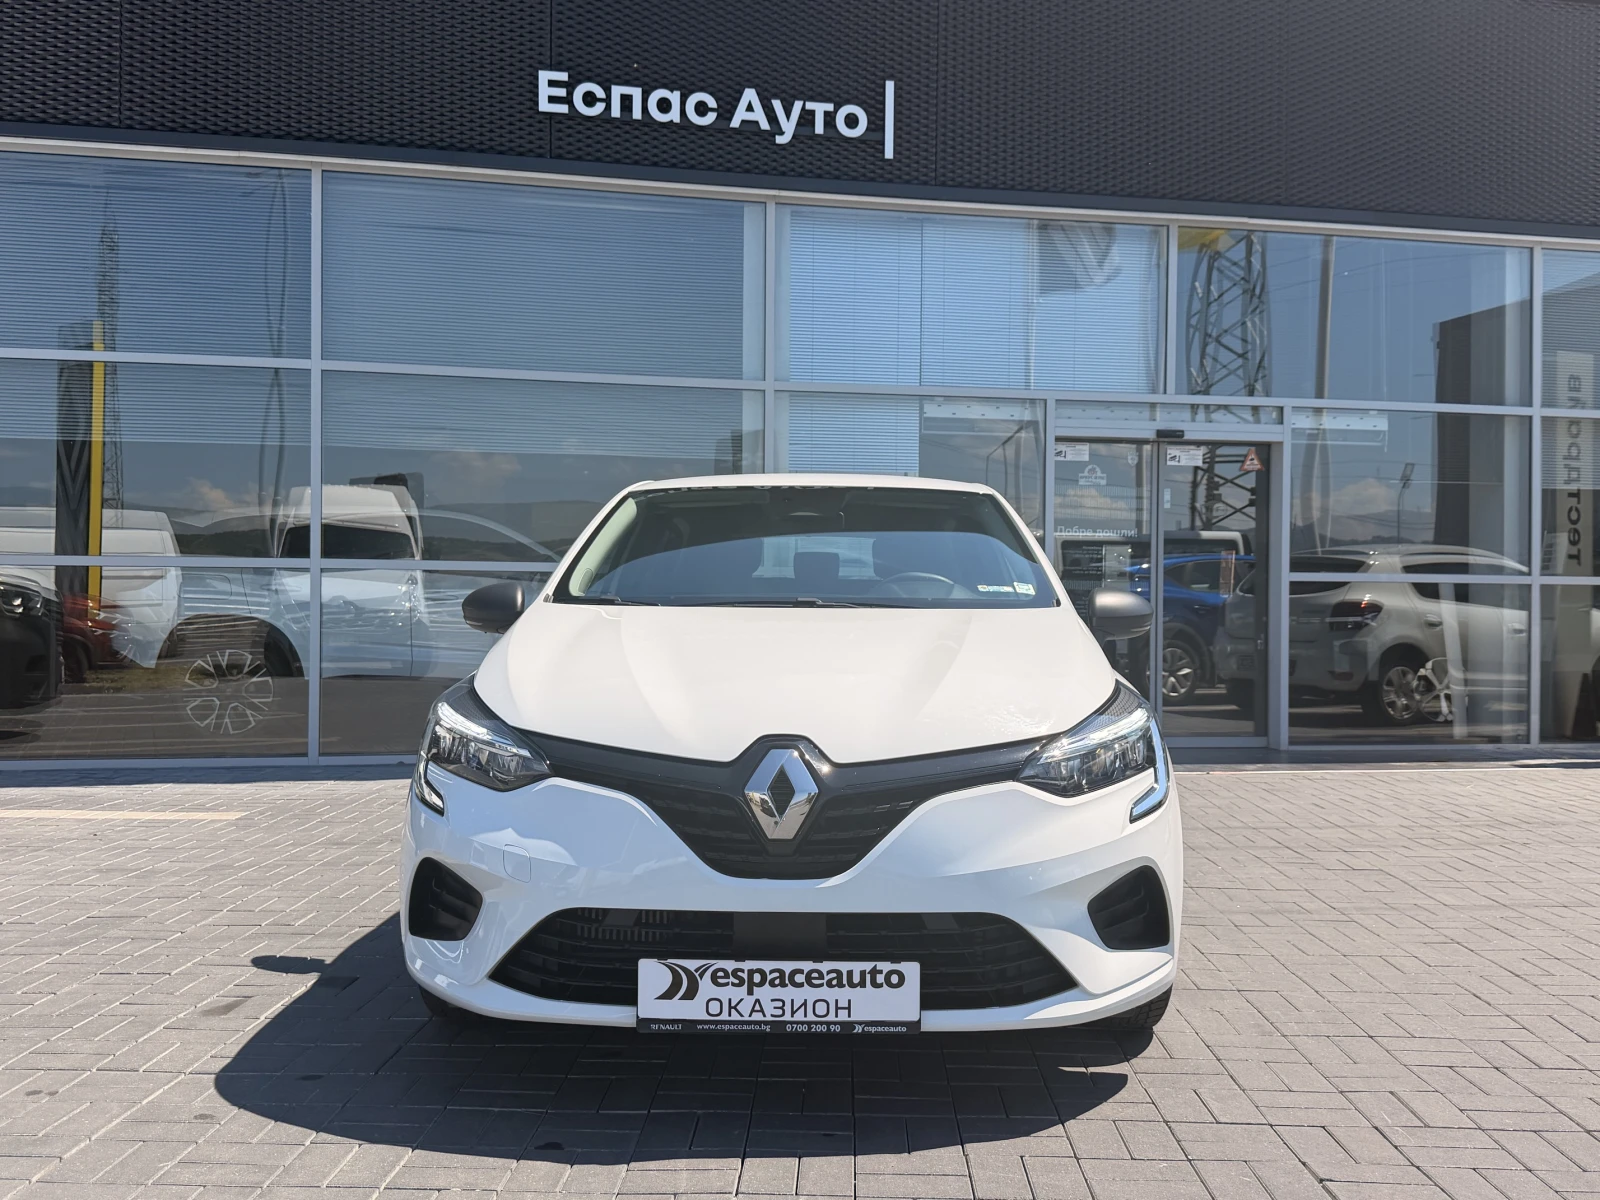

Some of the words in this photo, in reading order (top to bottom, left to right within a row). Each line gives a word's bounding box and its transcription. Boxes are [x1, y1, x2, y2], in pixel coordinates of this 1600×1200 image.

[538, 70, 718, 126] Еспас
[729, 88, 868, 144] Ауто
[1055, 526, 1093, 538] Добре
[1095, 528, 1138, 538] дошли!
[710, 964, 906, 996] espaceauto
[705, 997, 852, 1019] ОКАЗИОН
[696, 1023, 771, 1032] www.espaceauto.bg
[786, 1024, 808, 1032] 0700
[810, 1024, 827, 1032] 200
[829, 1024, 841, 1033] 90
[864, 1025, 907, 1034] espaceauto
